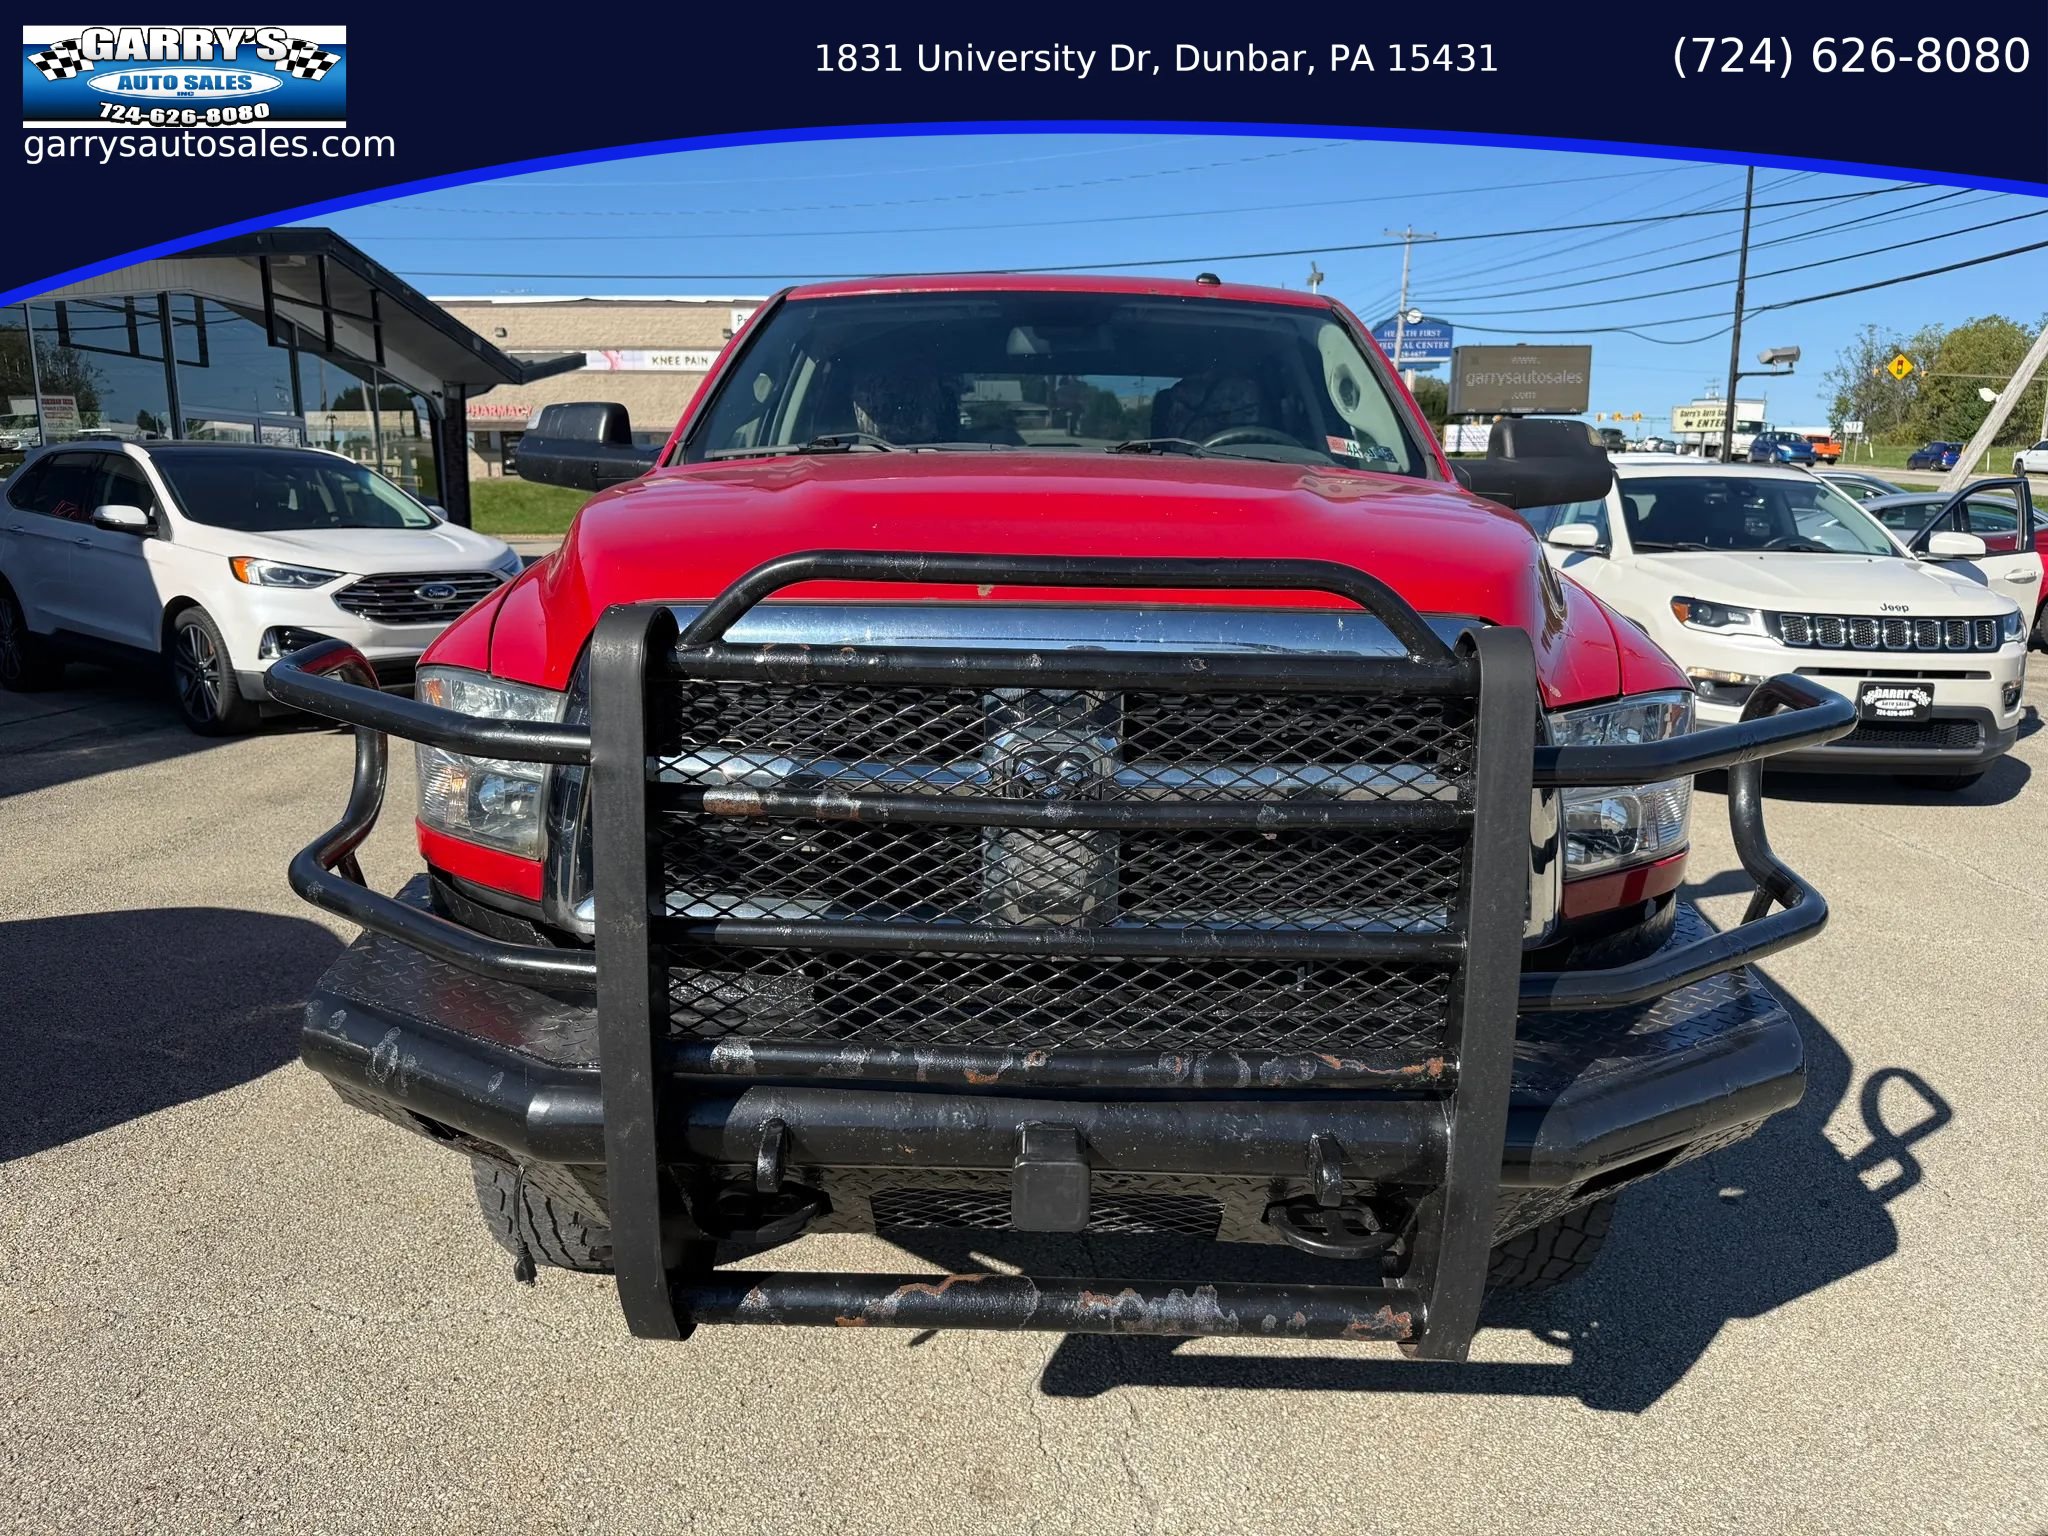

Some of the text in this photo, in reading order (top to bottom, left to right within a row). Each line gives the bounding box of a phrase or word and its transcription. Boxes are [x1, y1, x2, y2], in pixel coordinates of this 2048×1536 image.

[1384, 329, 1441, 338] HETH FIRST
[1380, 341, 1449, 350] EDAL CENTER
[652, 356, 709, 366] KNEE PAIN
[1466, 370, 1584, 387] garrysautosales
[1880, 602, 1909, 613] Jeep
